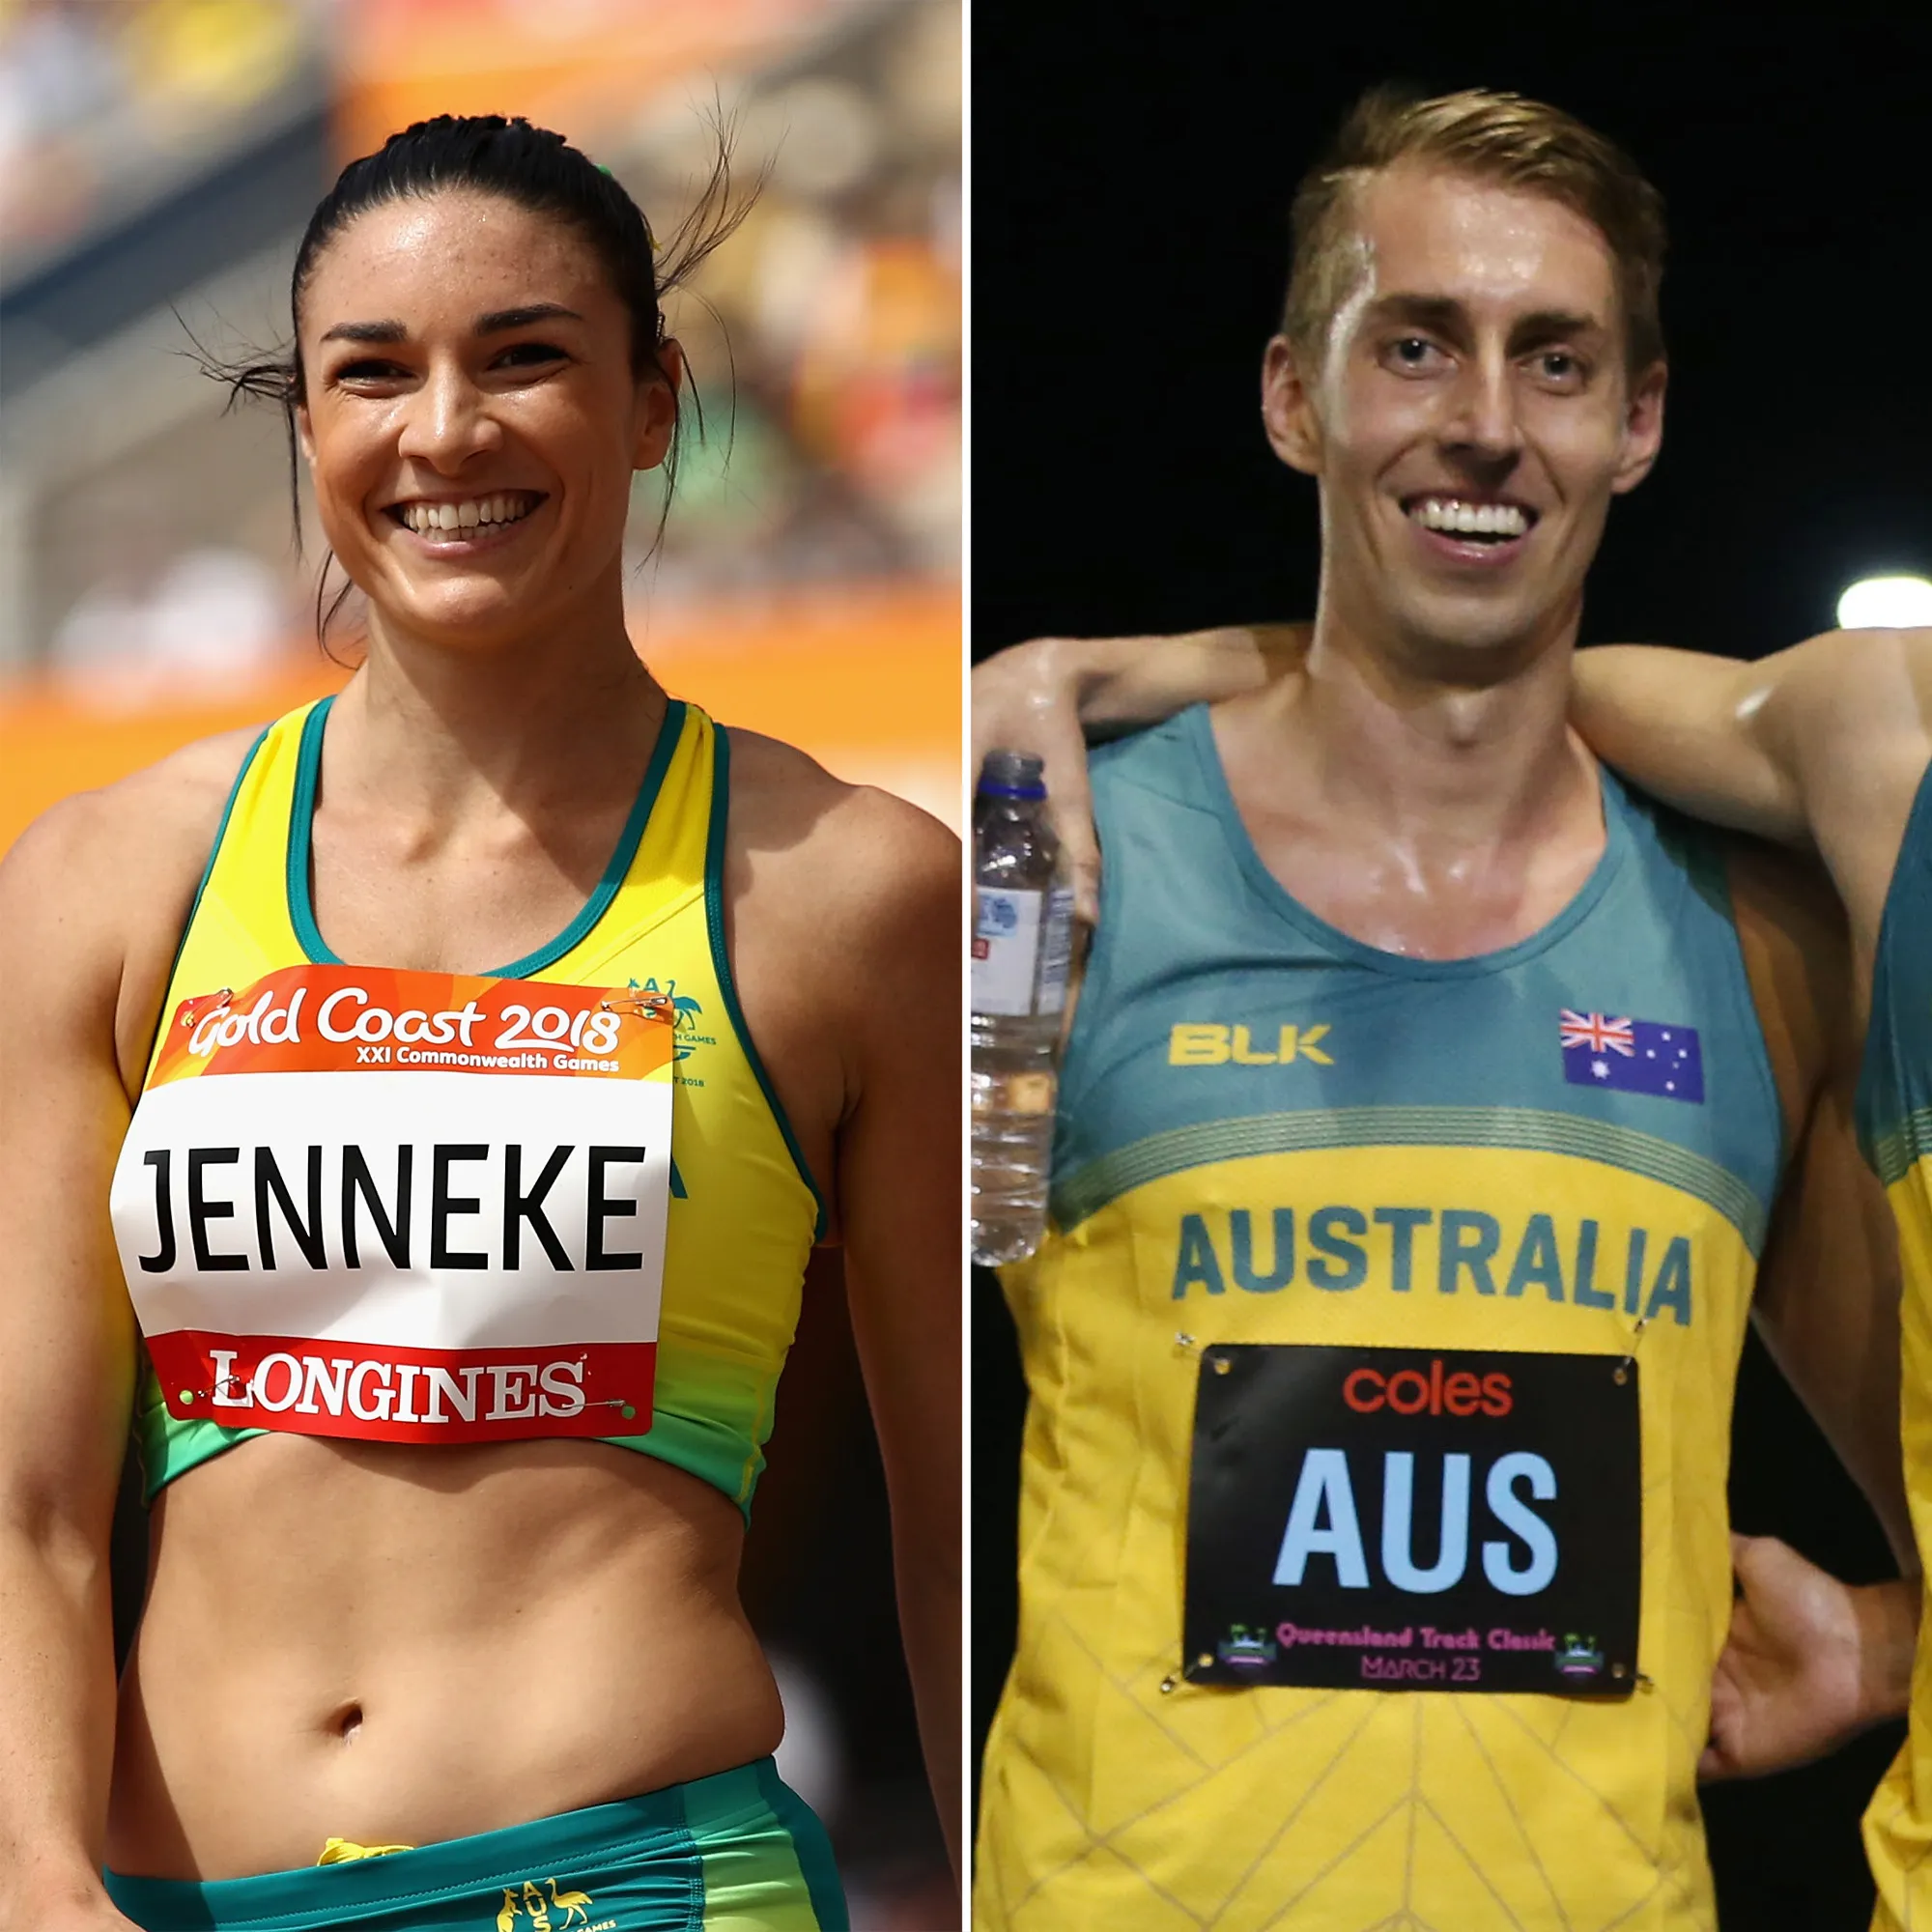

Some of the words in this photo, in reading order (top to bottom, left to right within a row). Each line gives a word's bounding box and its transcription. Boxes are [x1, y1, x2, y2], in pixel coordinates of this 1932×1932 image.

[187, 987, 308, 1057] Gold
[317, 987, 487, 1047] Coast
[494, 1004, 622, 1055] 2018
[684, 1034, 717, 1045] GAMES
[1168, 1024, 1334, 1066] BLK
[356, 1045, 391, 1064] XXI
[396, 1046, 548, 1070] Commonwealth
[554, 1054, 620, 1073] Games
[681, 1076, 705, 1088] 2018
[137, 1144, 646, 1272] JENNEKE
[1171, 1205, 1691, 1327] AUSTRALIA
[210, 1350, 586, 1424] LONGINES
[1343, 1359, 1513, 1417] coles
[1272, 1448, 1558, 1596] AUS
[1275, 1622, 1413, 1649] Queensland
[1419, 1627, 1480, 1650] Track
[1487, 1628, 1556, 1652] Classic
[1360, 1655, 1447, 1680] MARCH
[1451, 1657, 1481, 1681] 23
